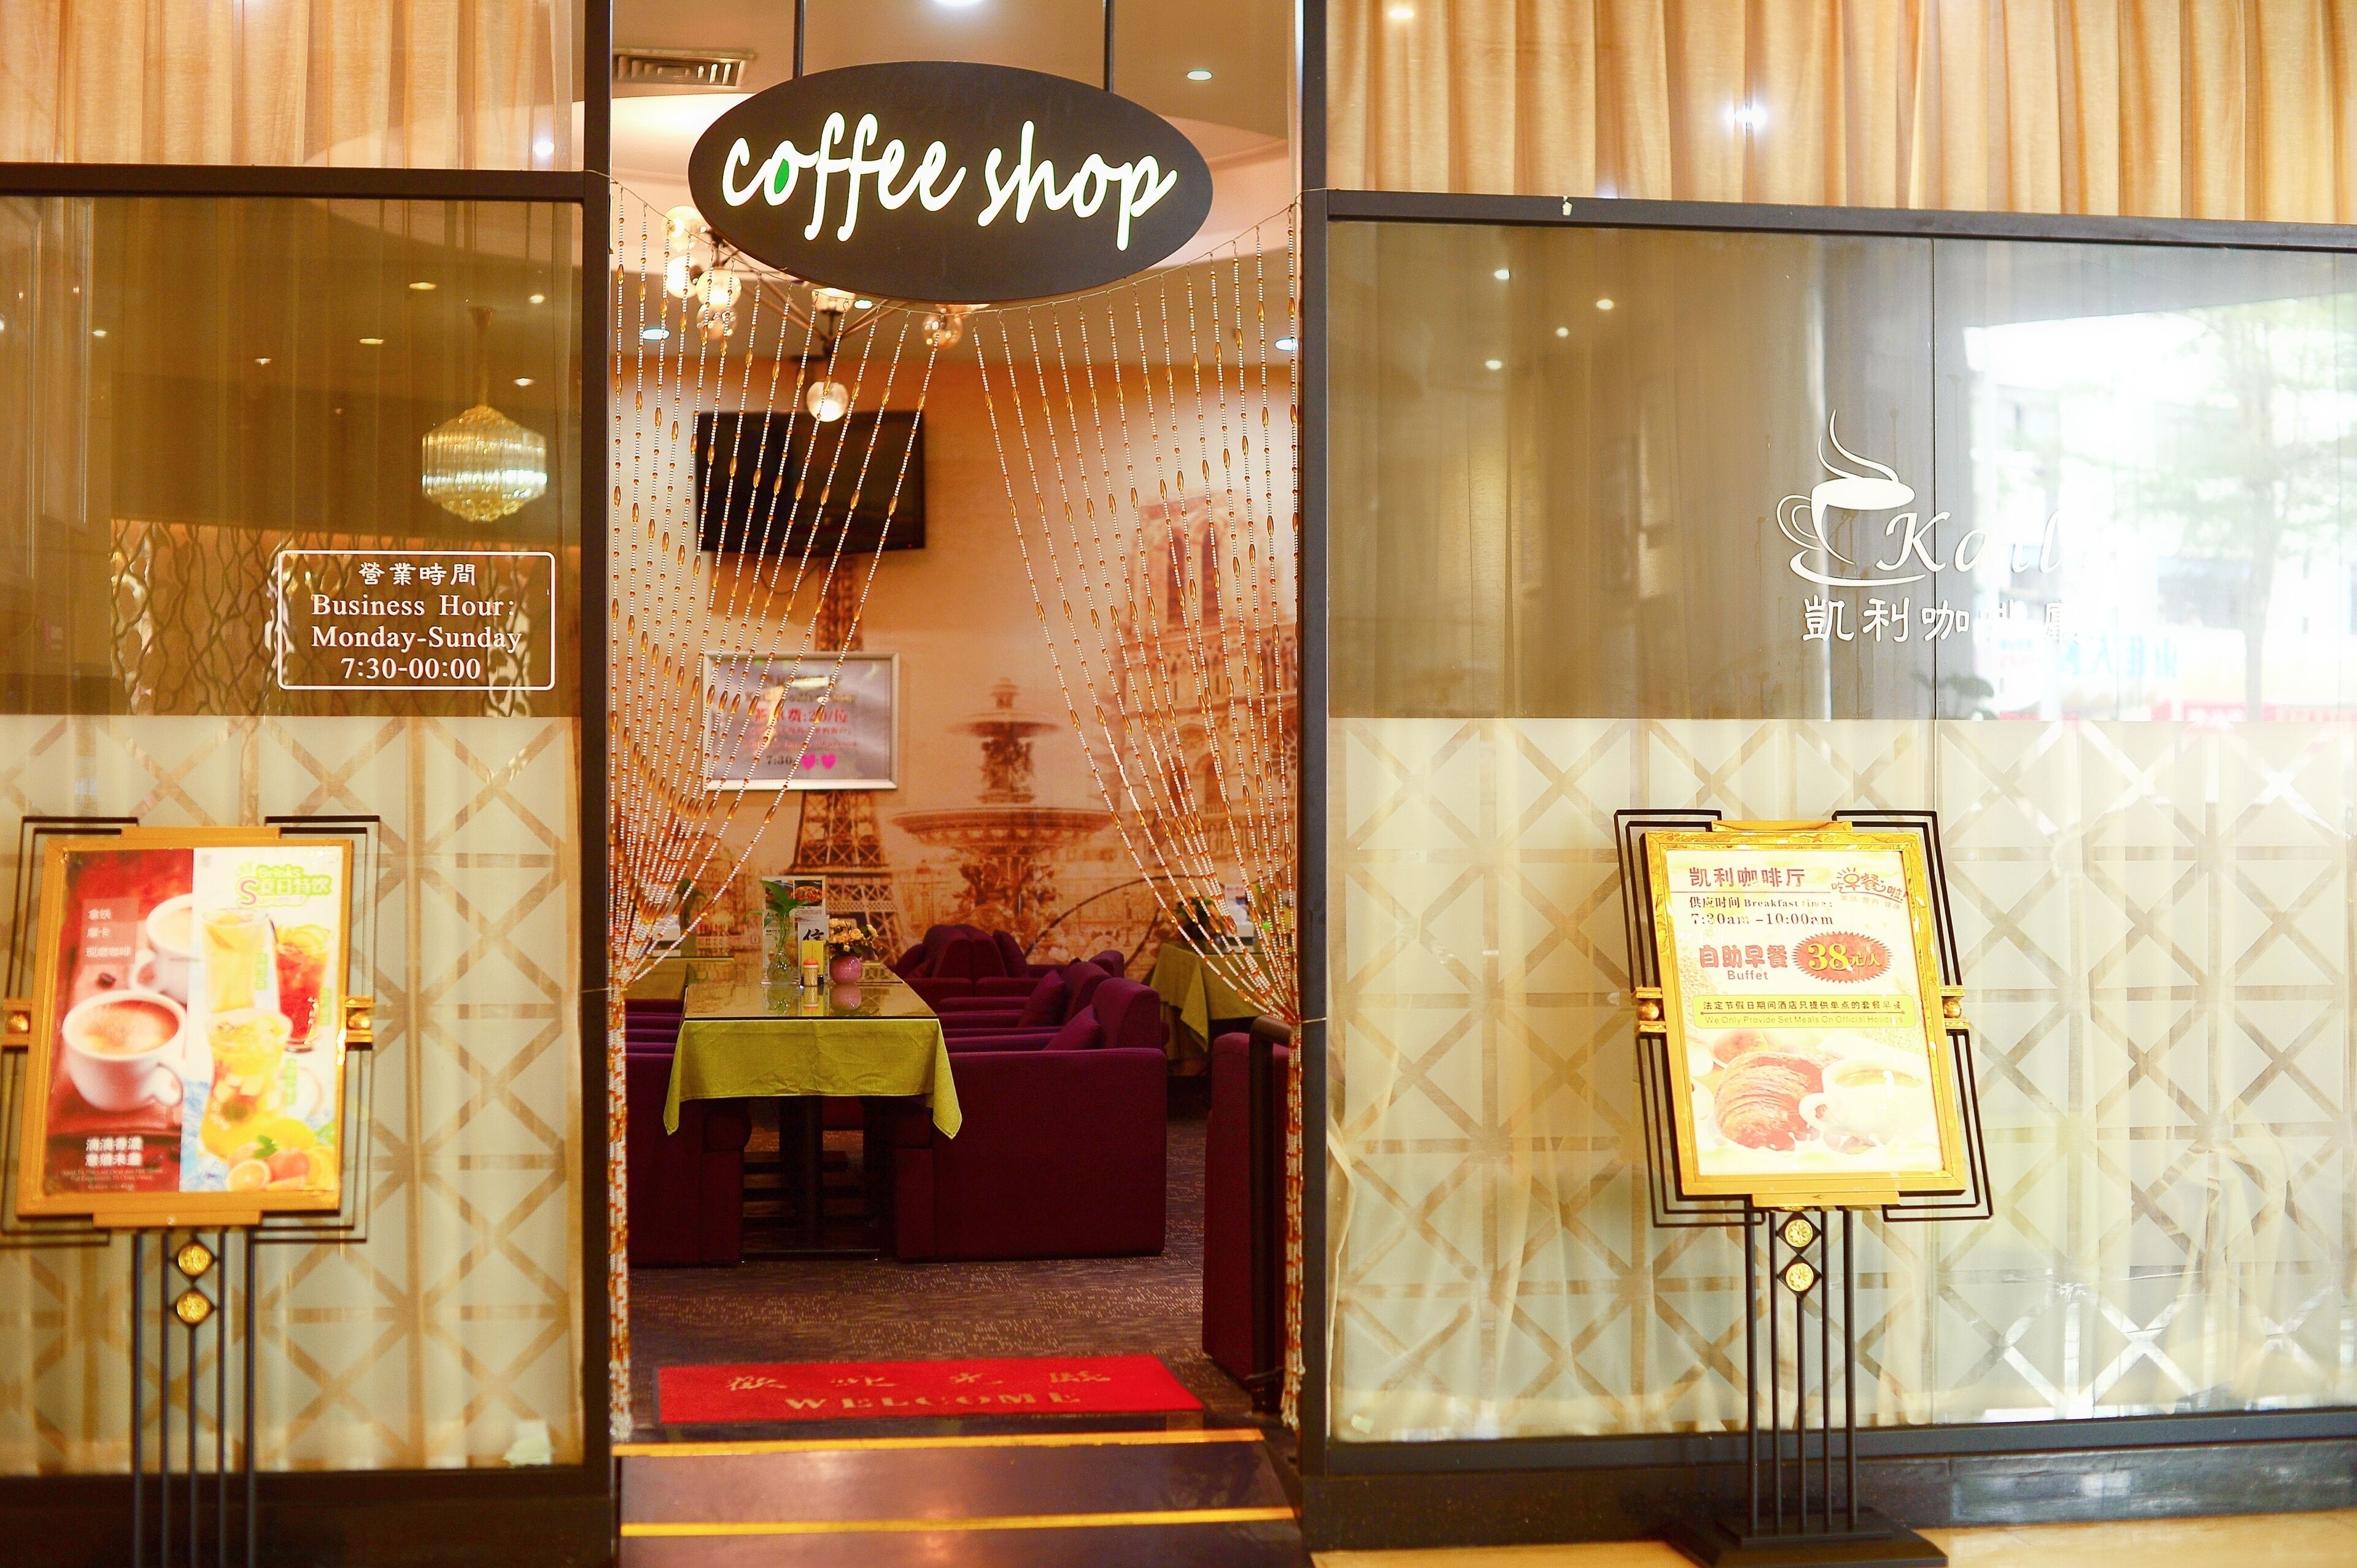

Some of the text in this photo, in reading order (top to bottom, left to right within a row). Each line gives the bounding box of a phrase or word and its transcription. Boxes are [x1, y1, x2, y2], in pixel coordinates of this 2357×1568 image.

[722, 112, 1178, 250] coffee shop
[358, 562, 476, 586] 營業時間
[311, 594, 515, 616] Business Hour:
[311, 626, 522, 653] Monday-Sunday
[341, 657, 481, 679] 7:30-00:00
[1689, 867, 1805, 887] 凯利咖啡厅
[1689, 896, 1740, 908] 供应时间
[1744, 898, 1798, 907] Breakfast
[1699, 944, 1787, 968] 自助早餐
[1727, 970, 1768, 980] Buffet
[1722, 1016, 1741, 1025] Only
[784, 1391, 1080, 1410] WELCOME
